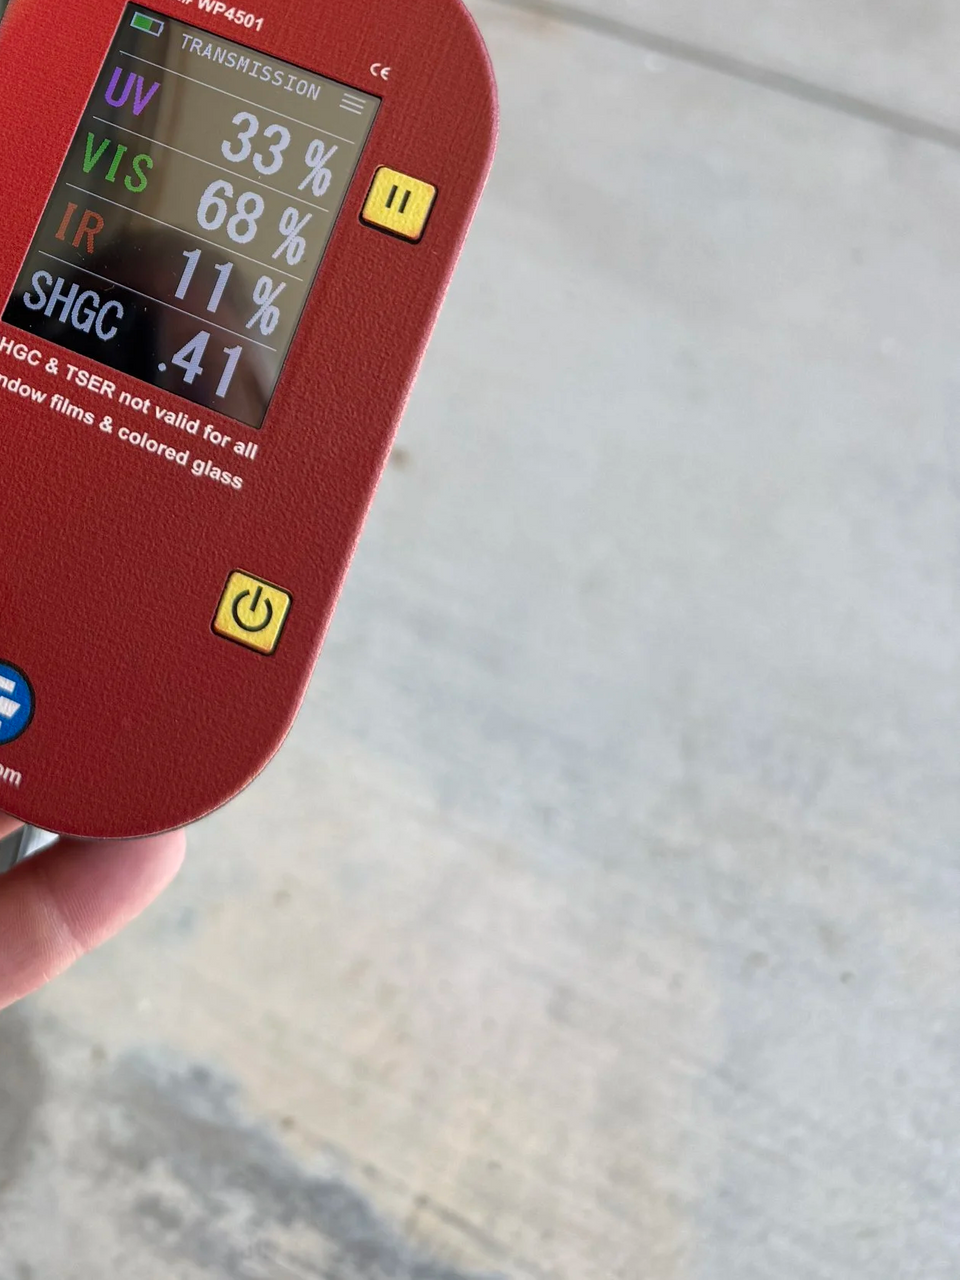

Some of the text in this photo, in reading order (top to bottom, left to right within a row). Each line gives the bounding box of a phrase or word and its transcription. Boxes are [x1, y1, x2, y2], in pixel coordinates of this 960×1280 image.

[104, 66, 160, 116] UV
[181, 33, 321, 102] TRANSMISSION
[80, 131, 154, 194] VIS
[220, 111, 291, 175] 33
[55, 201, 104, 254] IR
[197, 179, 265, 244] 68
[22, 270, 124, 341] SHGC
[174, 248, 234, 313] 11
[157, 330, 243, 398] .41
[45, 357, 59, 375] &
[65, 363, 116, 399] TSER
[118, 390, 152, 415] not
[155, 405, 200, 435] valid
[203, 424, 231, 448] for
[233, 439, 258, 460] all
[50, 393, 95, 426] films
[99, 415, 113, 434] &
[118, 425, 190, 466] colored
[191, 458, 244, 489] glass
